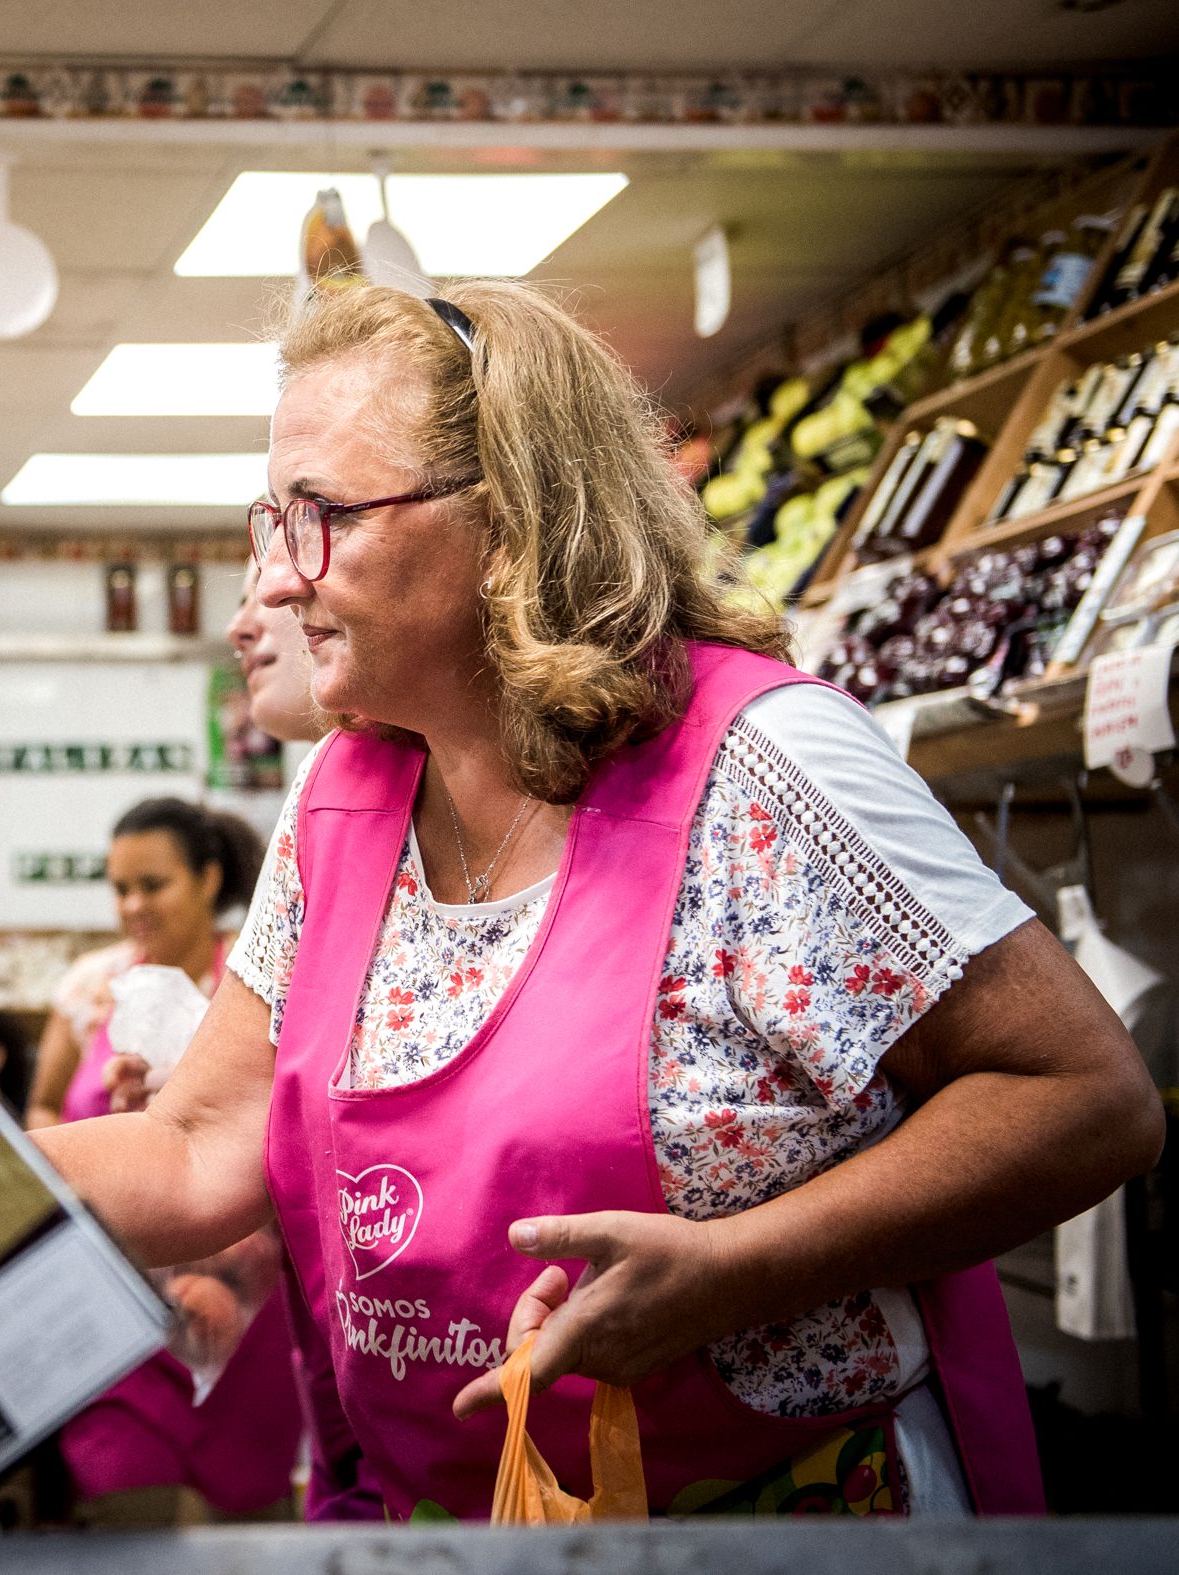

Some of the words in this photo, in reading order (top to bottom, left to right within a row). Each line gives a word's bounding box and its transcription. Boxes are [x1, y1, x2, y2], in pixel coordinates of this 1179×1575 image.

[338, 1175, 400, 1226] Pink
[348, 1207, 408, 1251] Lady
[349, 1291, 431, 1319] SOMOS
